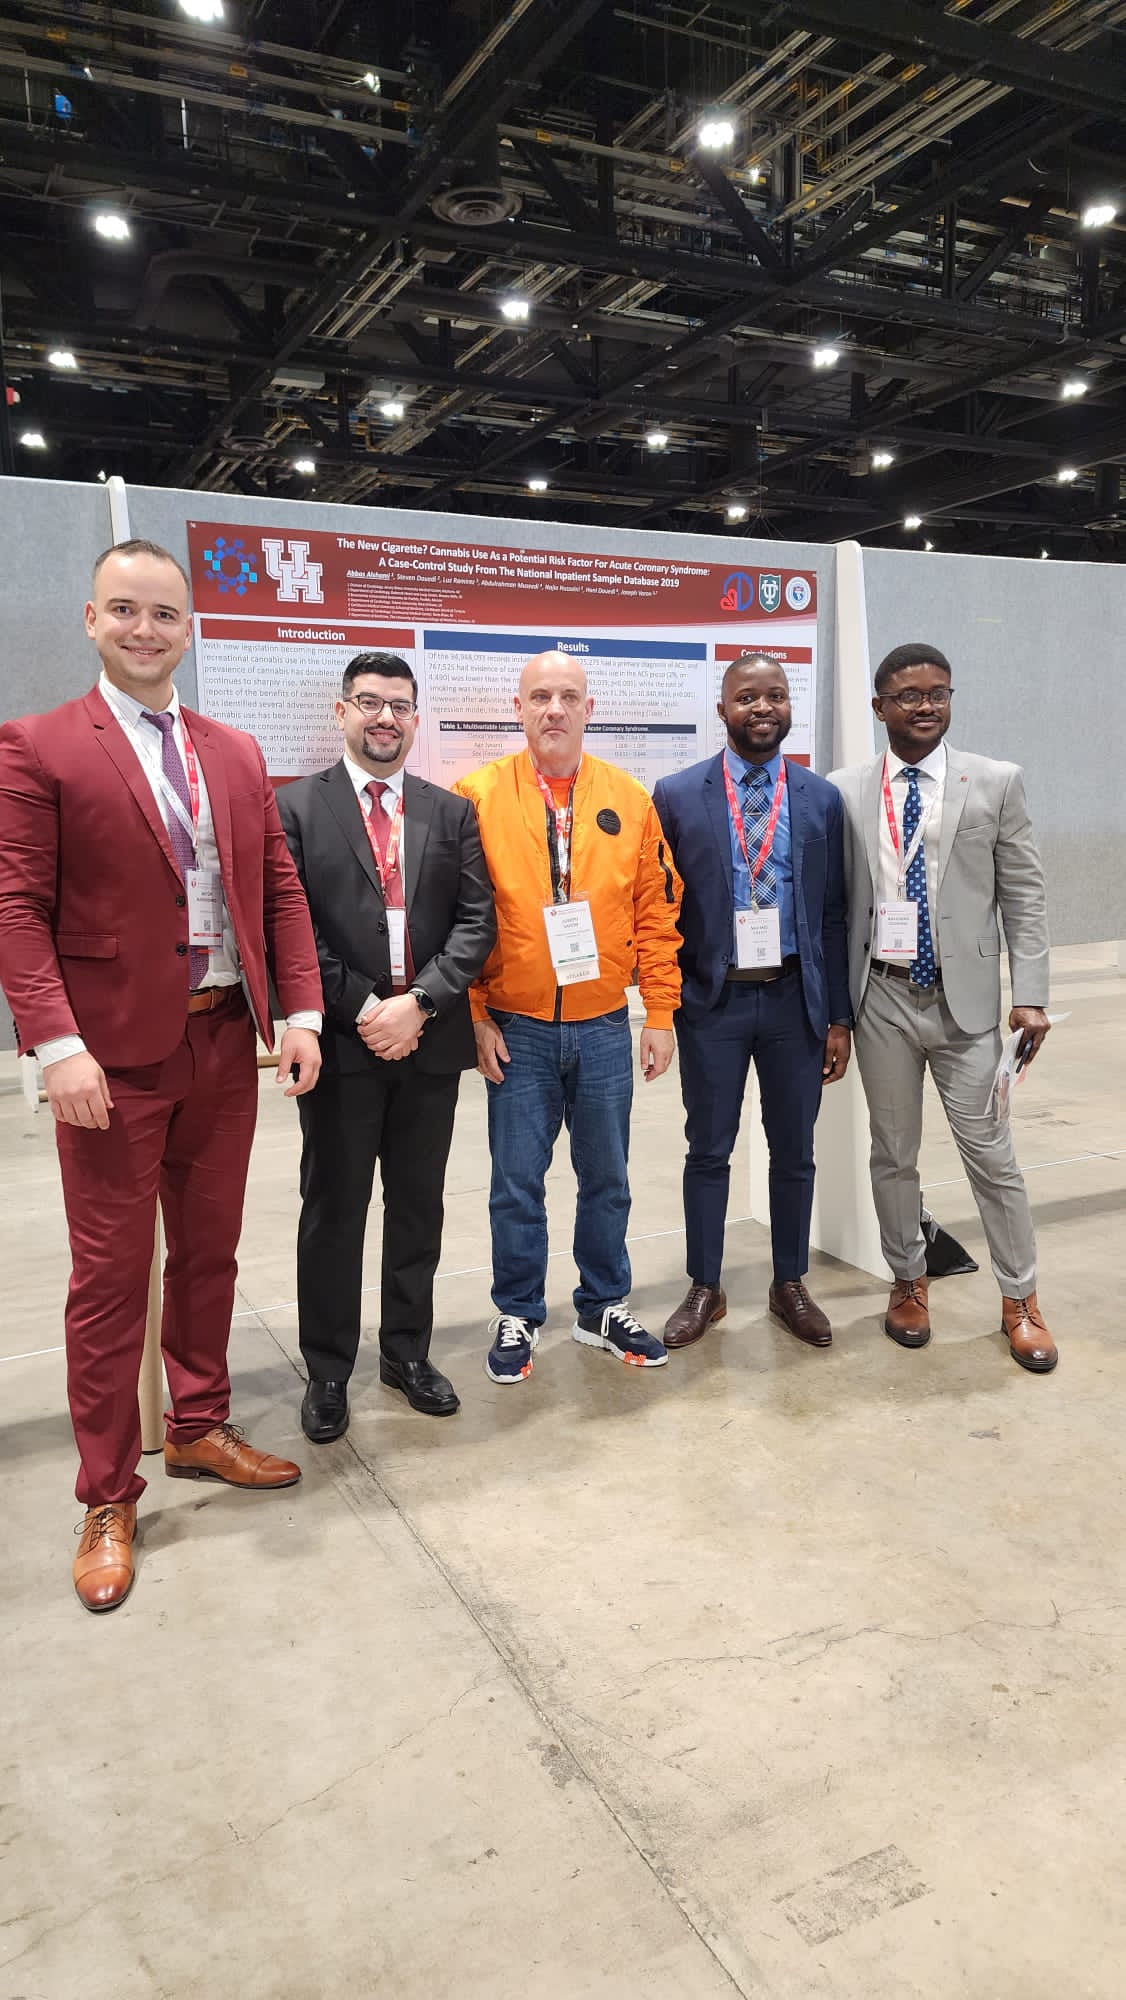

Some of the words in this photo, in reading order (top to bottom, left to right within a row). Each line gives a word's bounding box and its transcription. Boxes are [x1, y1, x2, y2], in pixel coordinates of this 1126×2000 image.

[337, 537, 354, 549] The
[358, 539, 378, 550] New
[382, 541, 428, 557] Cigarette?
[430, 544, 470, 557] Cannabis
[472, 547, 488, 559] Use
[490, 549, 500, 560] As
[502, 552, 508, 560] a
[510, 550, 546, 563] Potential
[549, 553, 566, 564] Risk
[568, 555, 592, 567] Factor
[594, 557, 608, 568] For
[609, 558, 632, 569] Acute
[634, 560, 668, 575] Coronary
[670, 562, 710, 578] Syndrome:
[379, 557, 386, 567] A
[388, 557, 446, 571] Case-Control
[448, 561, 474, 576] Study
[476, 563, 497, 575] From
[499, 565, 514, 576] The
[517, 566, 552, 579] National
[554, 569, 590, 584] Inpatient
[592, 572, 622, 586] Sample
[624, 574, 659, 586] Database
[660, 576, 680, 588] 2019
[278, 627, 346, 641] Introduction
[557, 641, 590, 652] Results
[250, 656, 282, 664] cannabis
